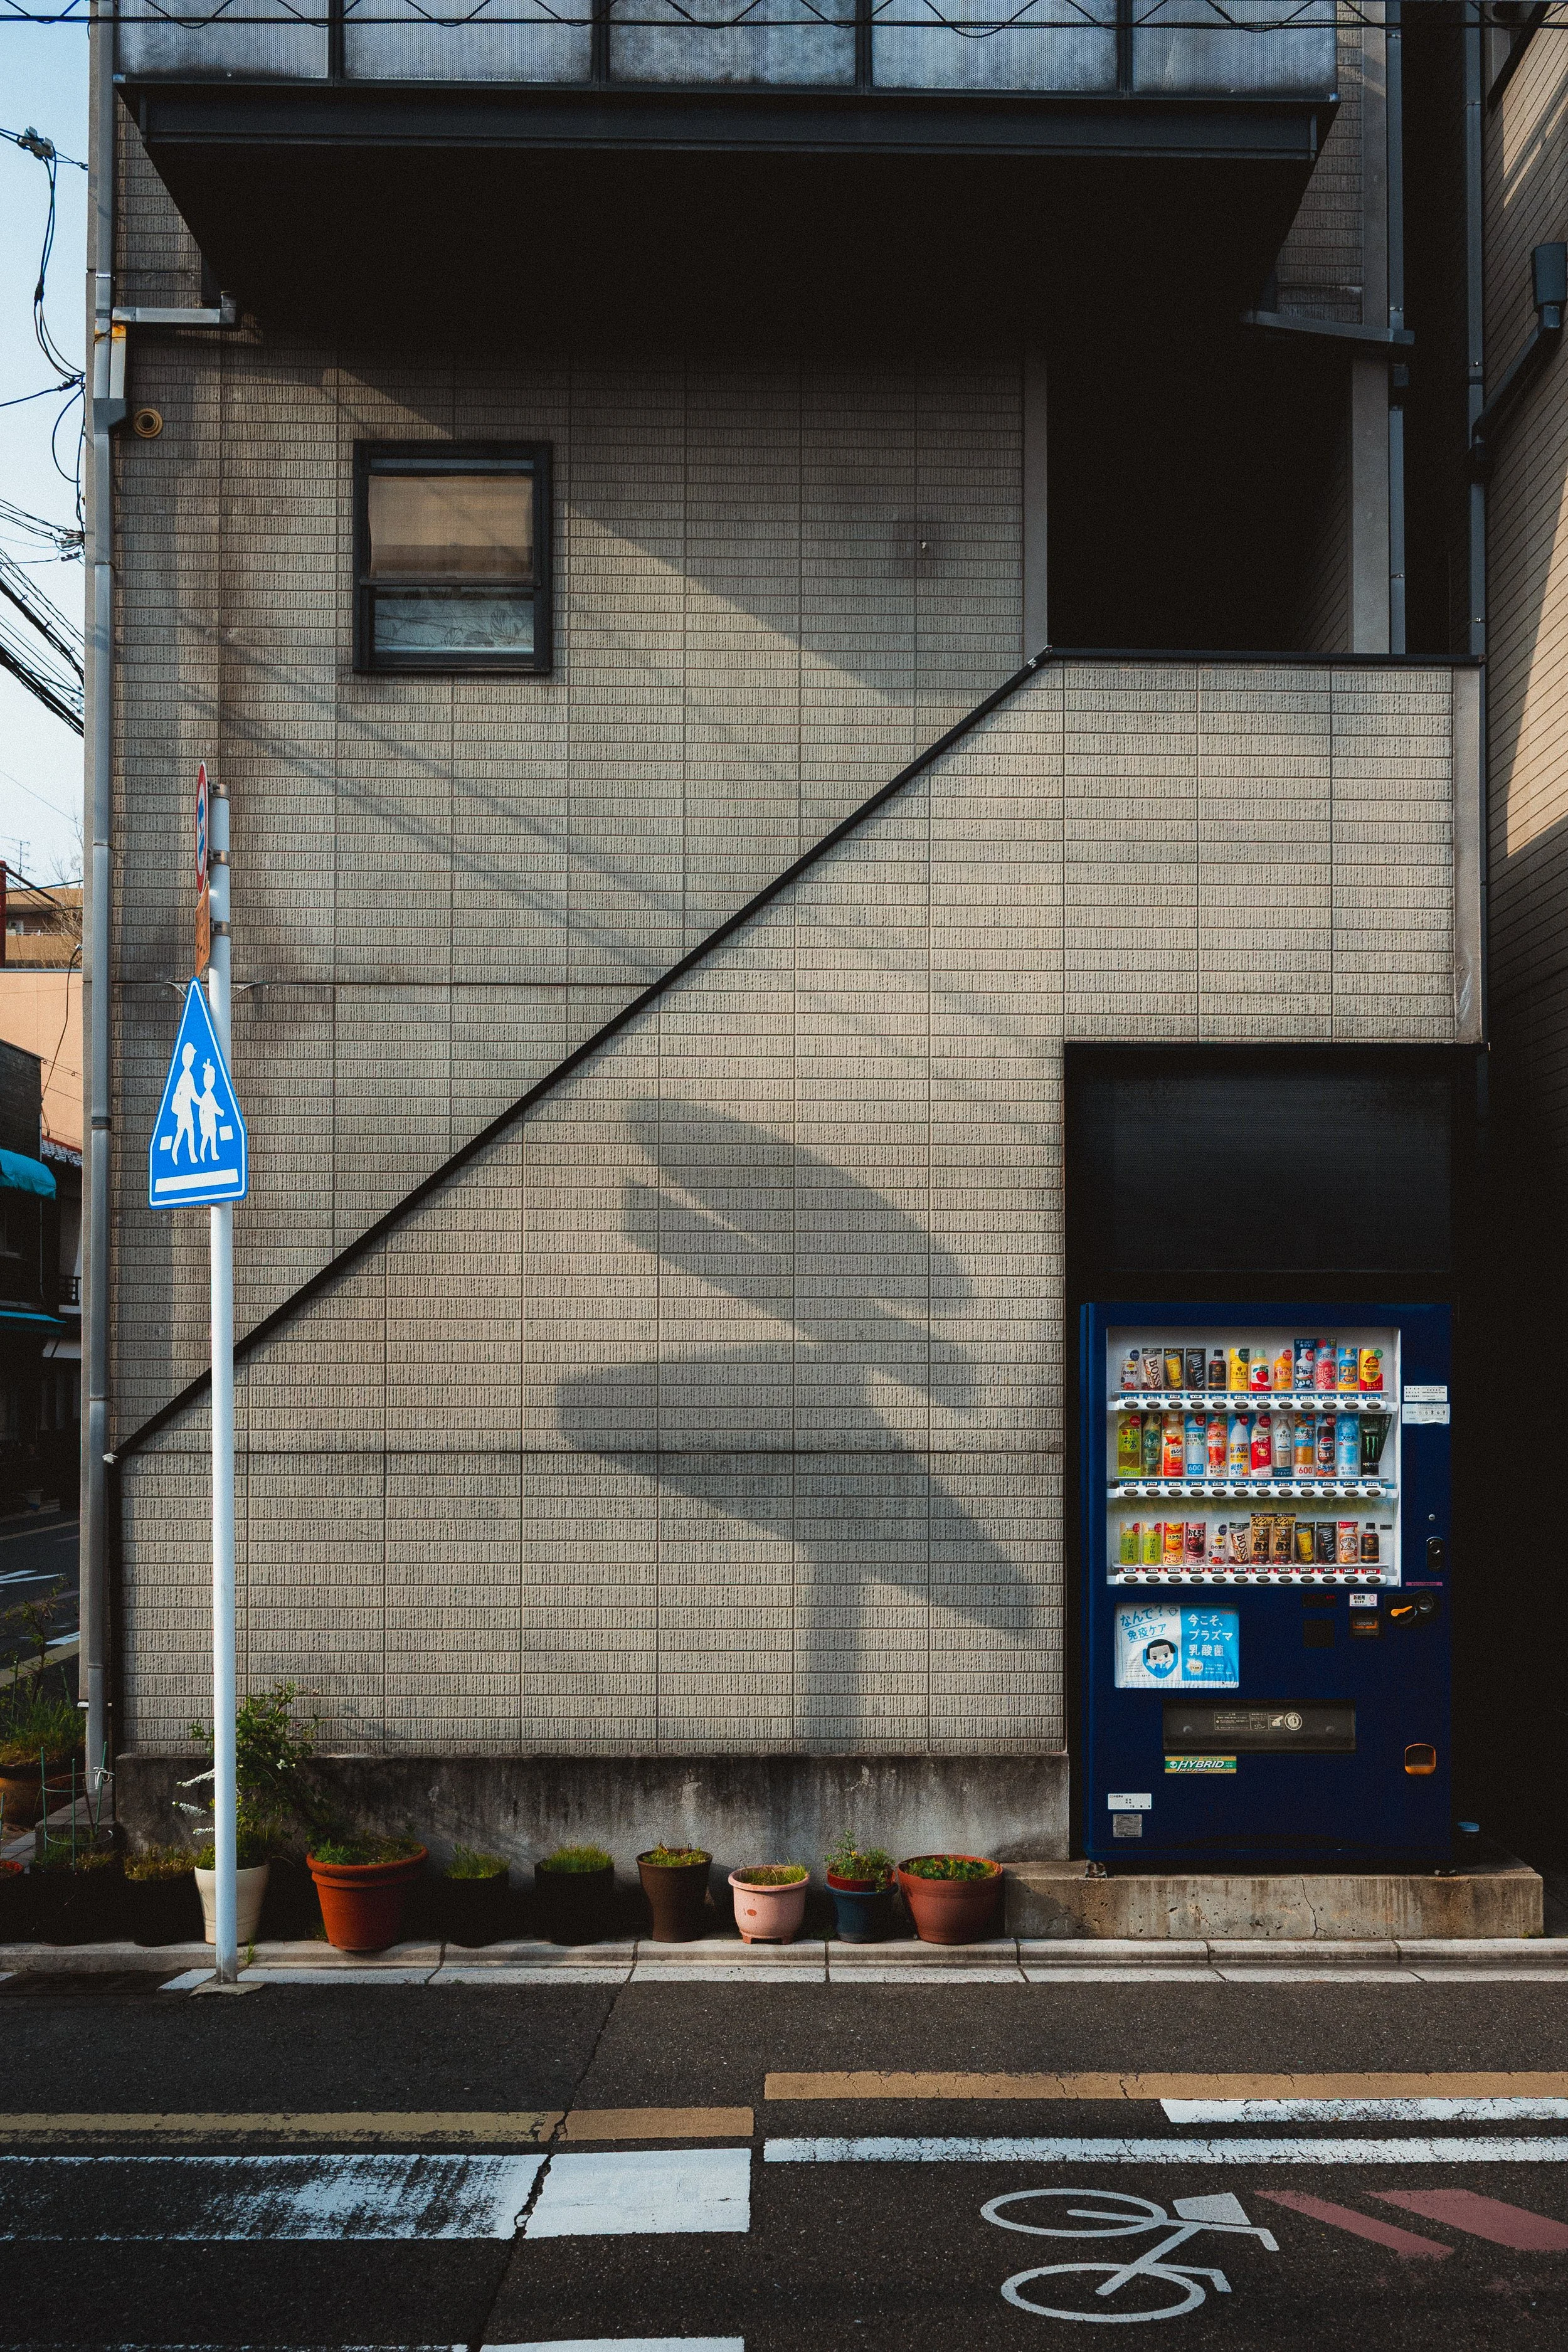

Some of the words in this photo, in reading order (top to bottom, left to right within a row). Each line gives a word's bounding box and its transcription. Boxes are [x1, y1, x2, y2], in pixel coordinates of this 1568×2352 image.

[1148, 1359, 1162, 1387] BOSS
[1192, 1358, 1205, 1388] BLACK
[1236, 1534, 1249, 1560] BOSS
[1322, 1532, 1335, 1561] BLACK
[1188, 1614, 1224, 1626] 今こそ、
[1128, 1623, 1167, 1641] 免疫ケア
[1189, 1629, 1233, 1641] プラズマ
[1189, 1644, 1224, 1657] 乳酸菌
[1176, 1761, 1224, 1772] HYBRID
